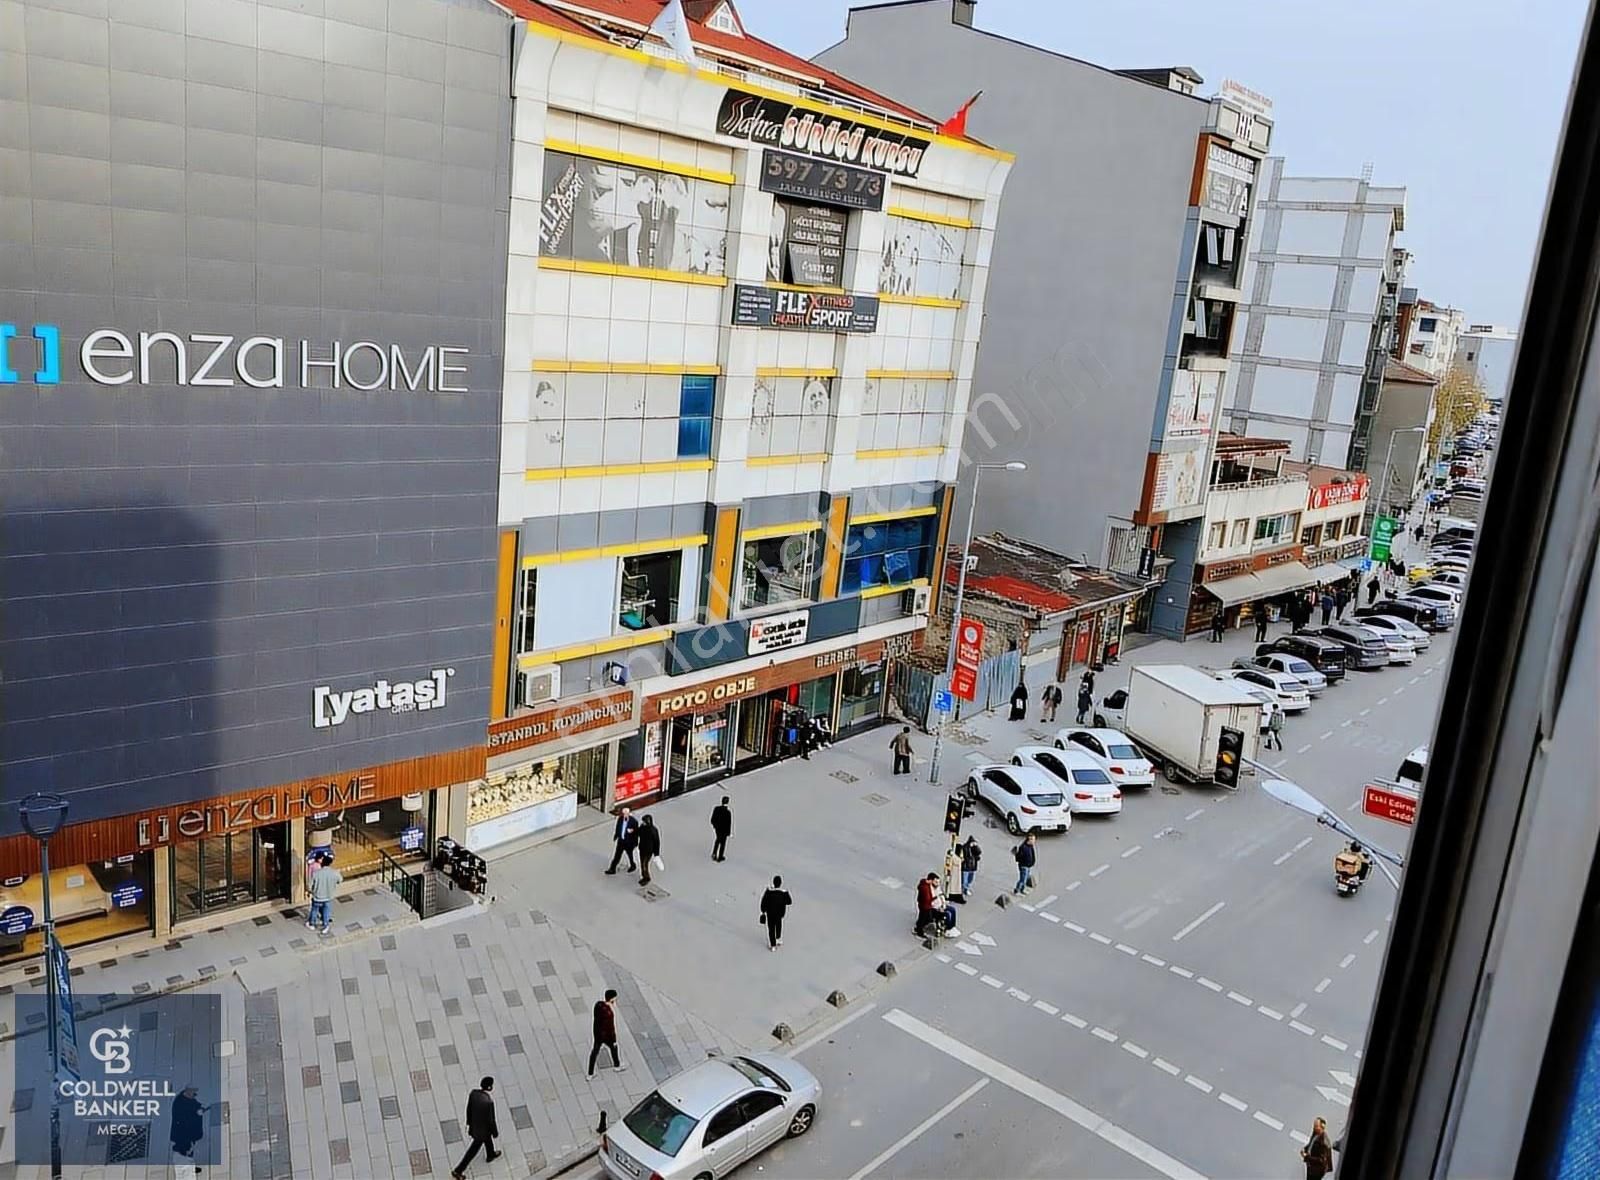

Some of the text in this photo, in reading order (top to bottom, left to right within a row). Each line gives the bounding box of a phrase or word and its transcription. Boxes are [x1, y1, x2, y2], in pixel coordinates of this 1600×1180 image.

[780, 113, 863, 161] SÜRÜCÜ
[861, 136, 922, 174] KURSU
[767, 155, 881, 196] 597 73 73
[776, 291, 819, 320] FLEX
[812, 308, 853, 327] SPORT
[80, 327, 469, 393] enza HOME
[816, 648, 857, 668] BERBER
[659, 677, 757, 715] FOTO OBJE
[178, 773, 377, 837] enza HOME
